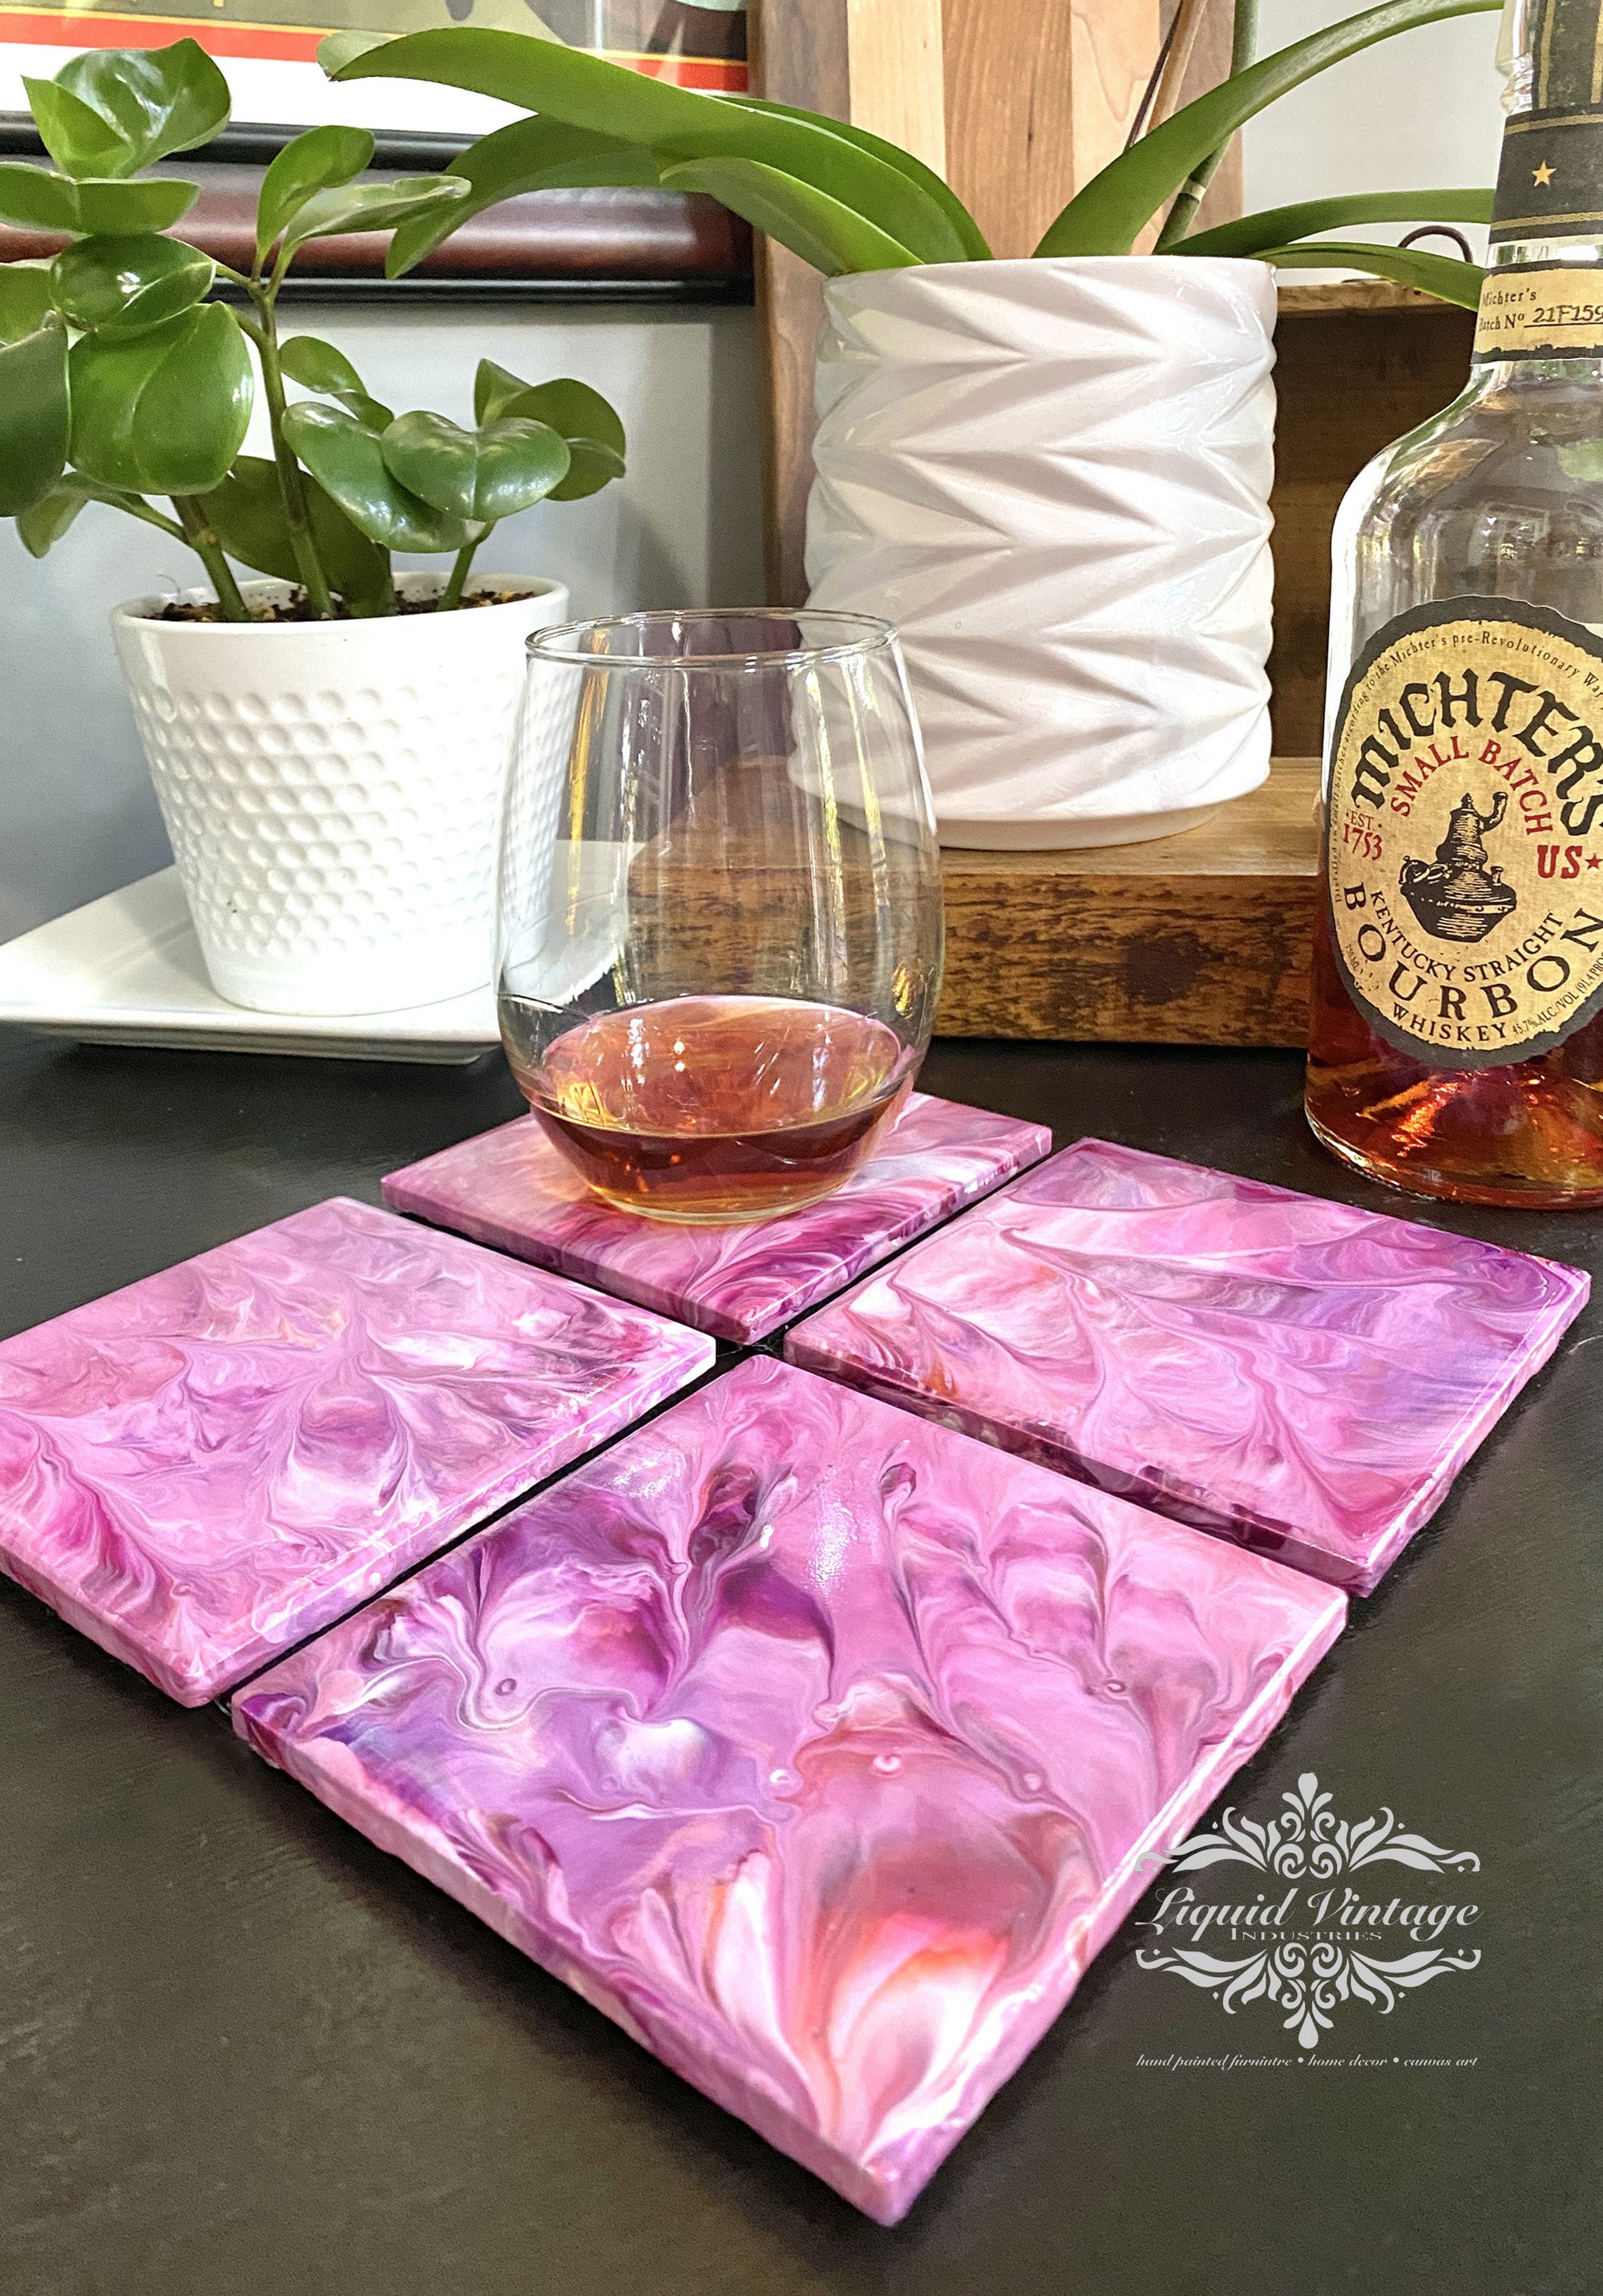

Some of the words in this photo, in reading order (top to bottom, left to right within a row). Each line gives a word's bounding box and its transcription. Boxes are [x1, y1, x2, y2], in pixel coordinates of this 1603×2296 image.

[1483, 288, 1536, 306] Michter's
[1374, 663, 1391, 680] the
[1390, 634, 1448, 667] Michter's
[1452, 631, 1581, 678] pre-Revolutionary
[1390, 736, 1469, 817] SMALL
[1478, 739, 1553, 835] BATCH
[1343, 823, 1382, 861] 1753
[1343, 882, 1603, 1020] BOURBON
[1371, 890, 1456, 982] KENTUCKY
[1464, 912, 1564, 983] STRAIGHT
[1392, 1002, 1507, 1042] WHISKEY
